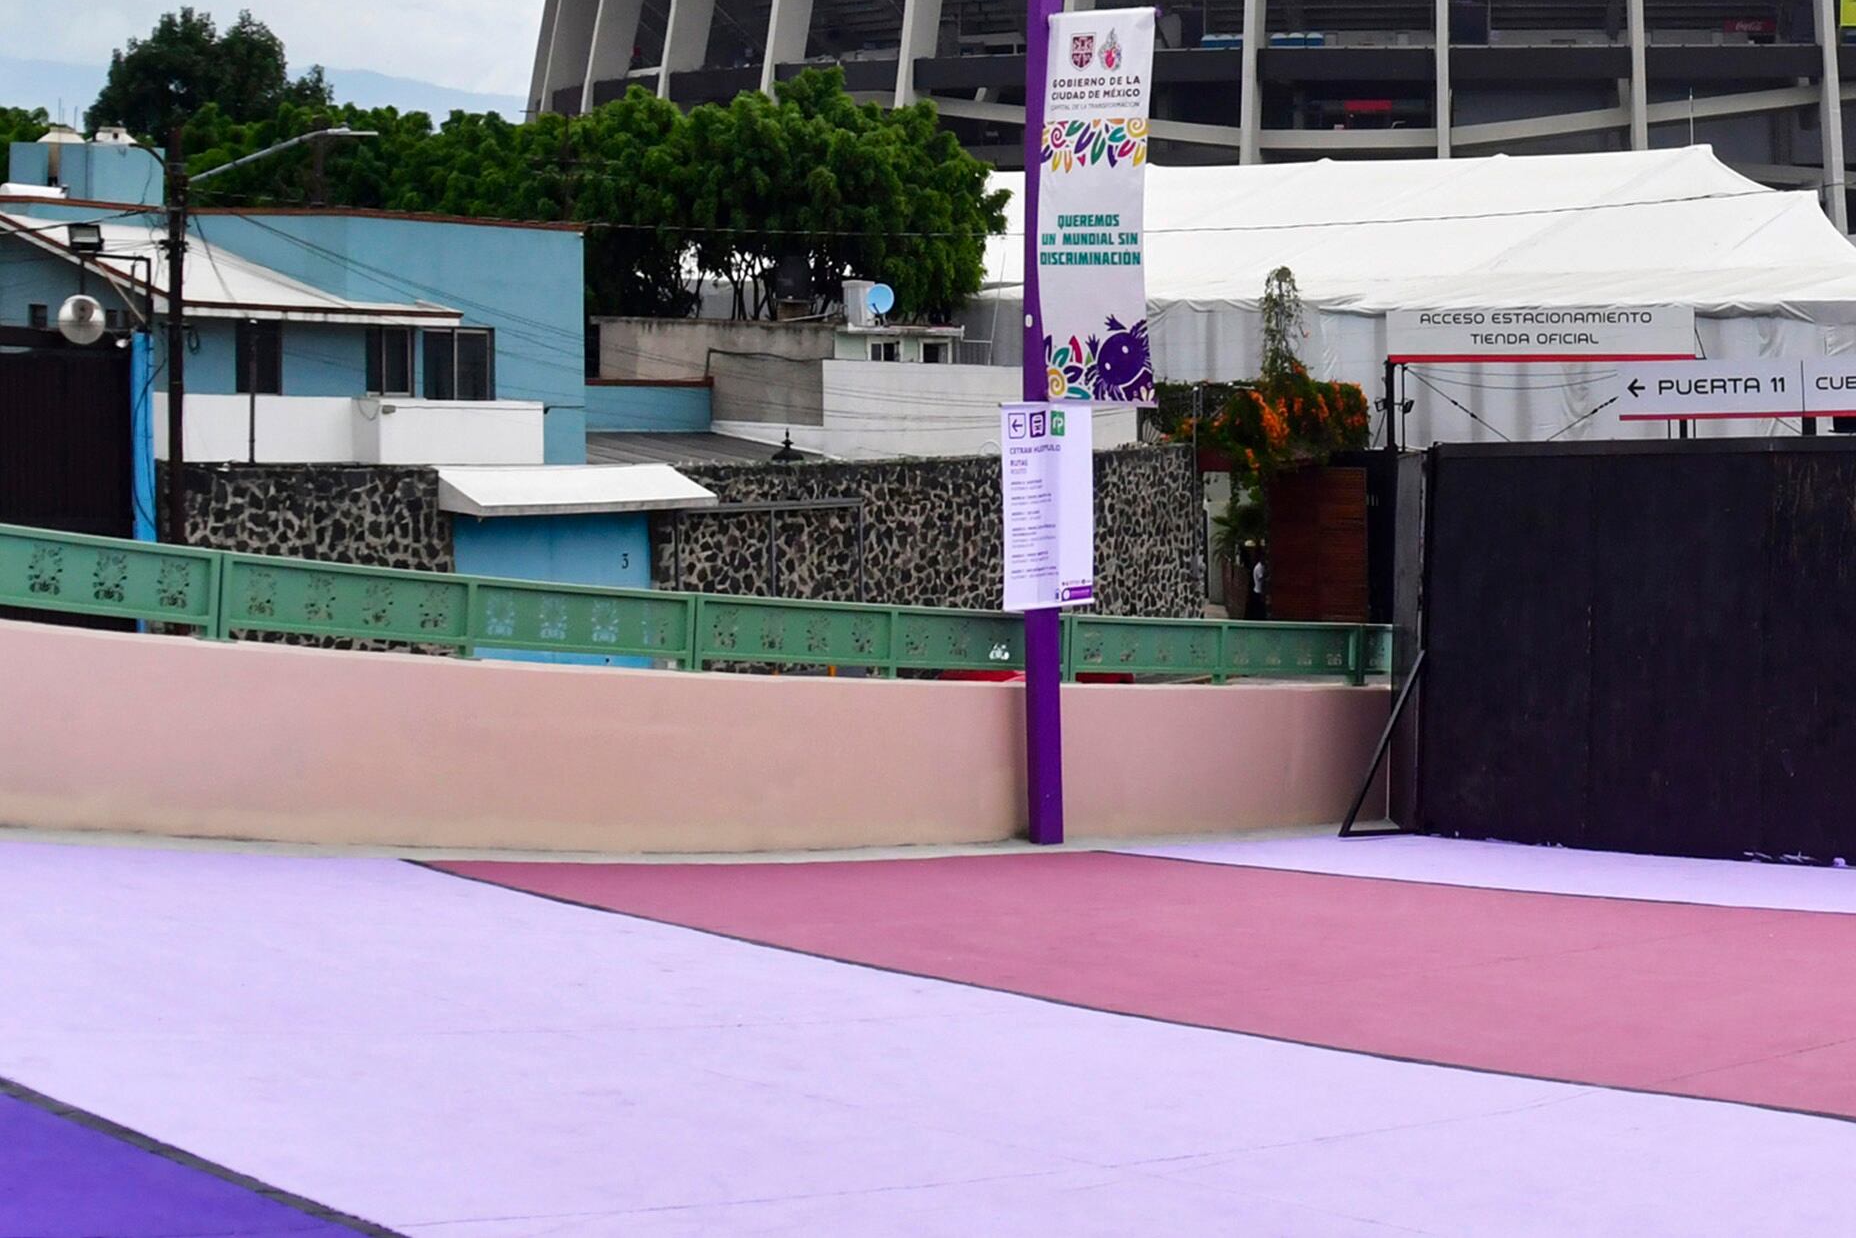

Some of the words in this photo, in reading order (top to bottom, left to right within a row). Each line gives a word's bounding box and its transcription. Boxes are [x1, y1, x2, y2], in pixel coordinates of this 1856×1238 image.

[1052, 77, 1105, 88] GOBIERNO
[1109, 76, 1122, 85] DE
[1126, 75, 1140, 84] LA
[1051, 90, 1086, 100] CIUDAD
[1088, 90, 1100, 98] DE
[1103, 88, 1140, 98] MÉXICO
[1057, 214, 1120, 229] QUEREMOS
[1042, 233, 1056, 245] UN
[1062, 233, 1114, 245] MUNDIAL
[1118, 232, 1138, 245] SIN
[1040, 249, 1141, 265] DISCRIMINACIÓN
[1420, 313, 1485, 325] ACCESO
[1491, 311, 1652, 325] ESTACIONAMIENTO
[1470, 333, 1530, 345] TIENDA
[1536, 332, 1599, 345] OFICIAL
[1658, 377, 1760, 395] PUERTA
[1770, 377, 1786, 393] 11
[621, 553, 629, 569] 3
